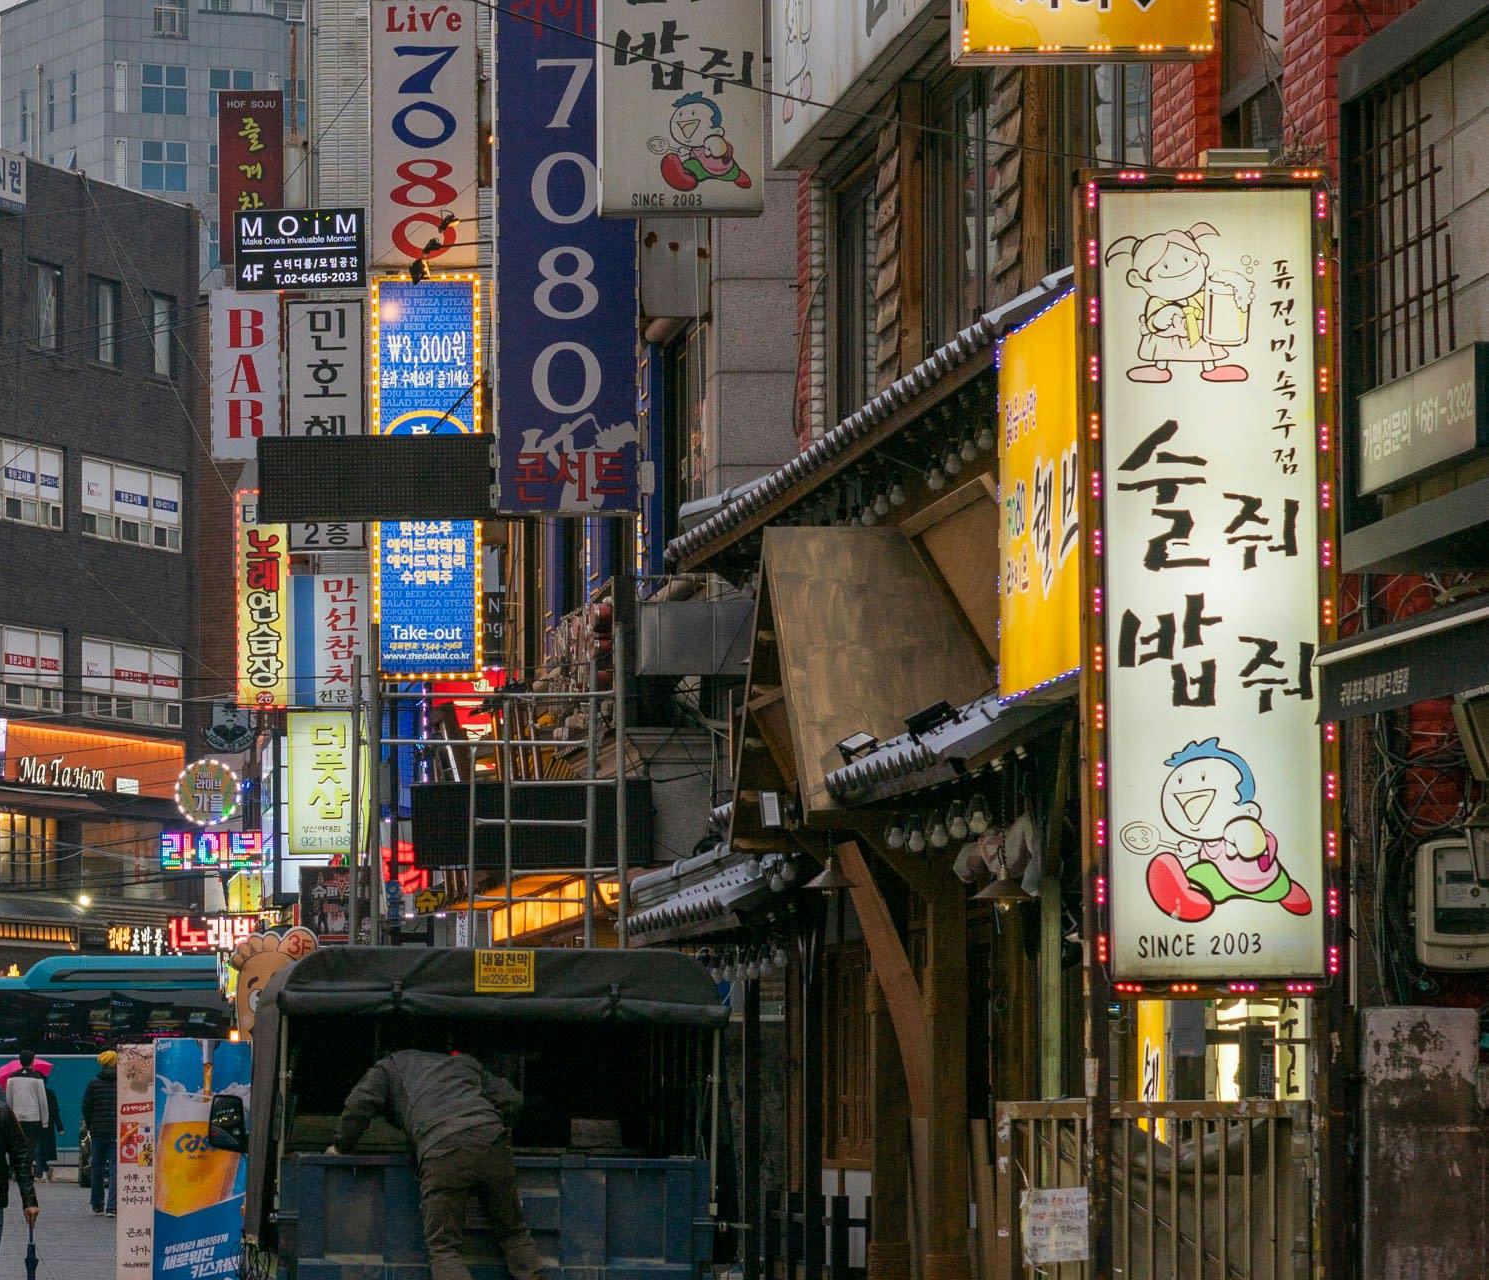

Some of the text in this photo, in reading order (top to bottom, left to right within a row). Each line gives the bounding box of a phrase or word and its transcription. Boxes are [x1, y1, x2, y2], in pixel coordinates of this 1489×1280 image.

[385, 5, 462, 33] Live
[226, 99, 277, 109] HOF SOJU
[389, 45, 460, 260] 7080
[631, 193, 704, 208] SINCE 2003
[242, 234, 357, 246] Make One's Moment
[531, 58, 603, 416] 7080
[242, 263, 264, 282] 4F
[274, 272, 358, 285] T.02-6465-2033
[387, 330, 467, 369] ₩3,800원
[225, 308, 264, 439] BAR
[1270, 258, 1301, 476] 퓨전민속주점
[1414, 379, 1473, 437] 1661-3392
[513, 449, 627, 505] 콘서트
[400, 570, 453, 585] 수입맥주
[245, 529, 284, 689] 노래연습장
[390, 625, 462, 641] Take-out
[19, 756, 72, 787] Ma Ta
[194, 778, 223, 791] 라이브
[309, 723, 351, 820] 더풋샵
[194, 793, 224, 814] 가을
[161, 832, 263, 871] 라이브
[286, 934, 313, 956] 3F
[1136, 930, 1264, 960] SINCE 2003
